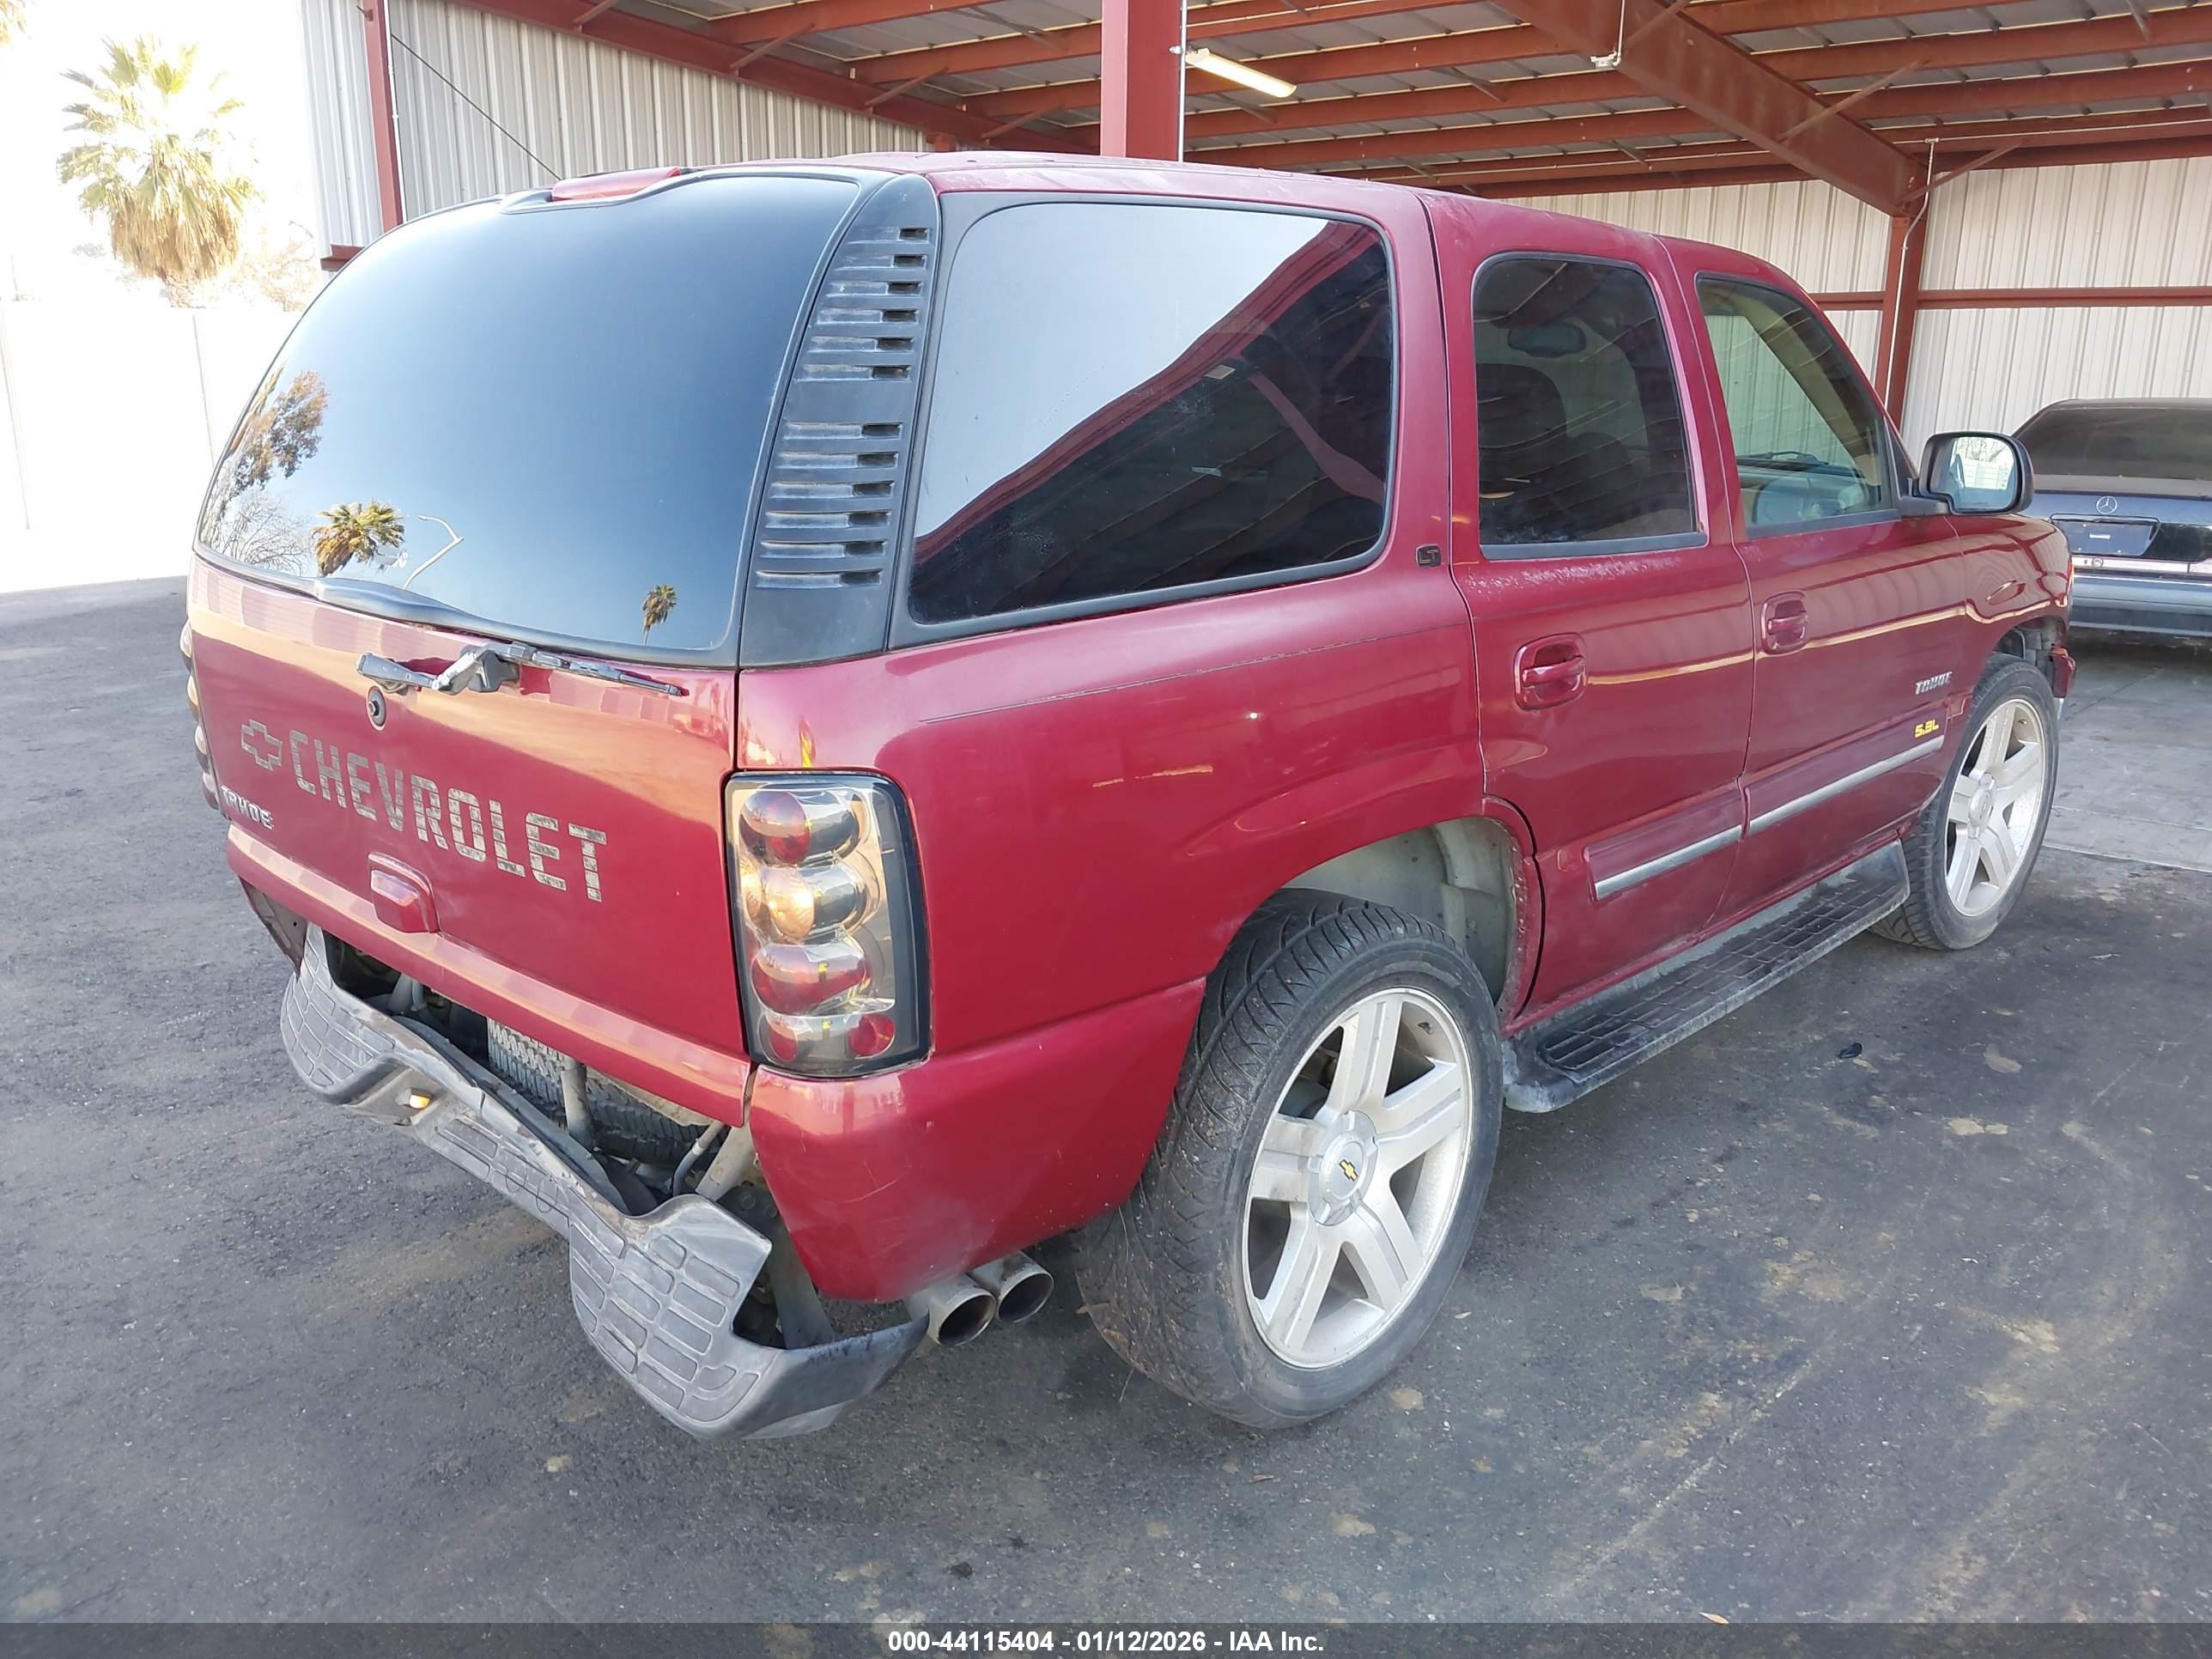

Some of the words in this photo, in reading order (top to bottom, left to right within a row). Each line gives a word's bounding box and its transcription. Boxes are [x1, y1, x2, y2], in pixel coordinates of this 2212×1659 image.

[1419, 549, 1439, 564] LT
[1916, 672, 1953, 695] TAHOE
[221, 784, 275, 830] TAHOE
[289, 730, 606, 902] CHEVROLET
